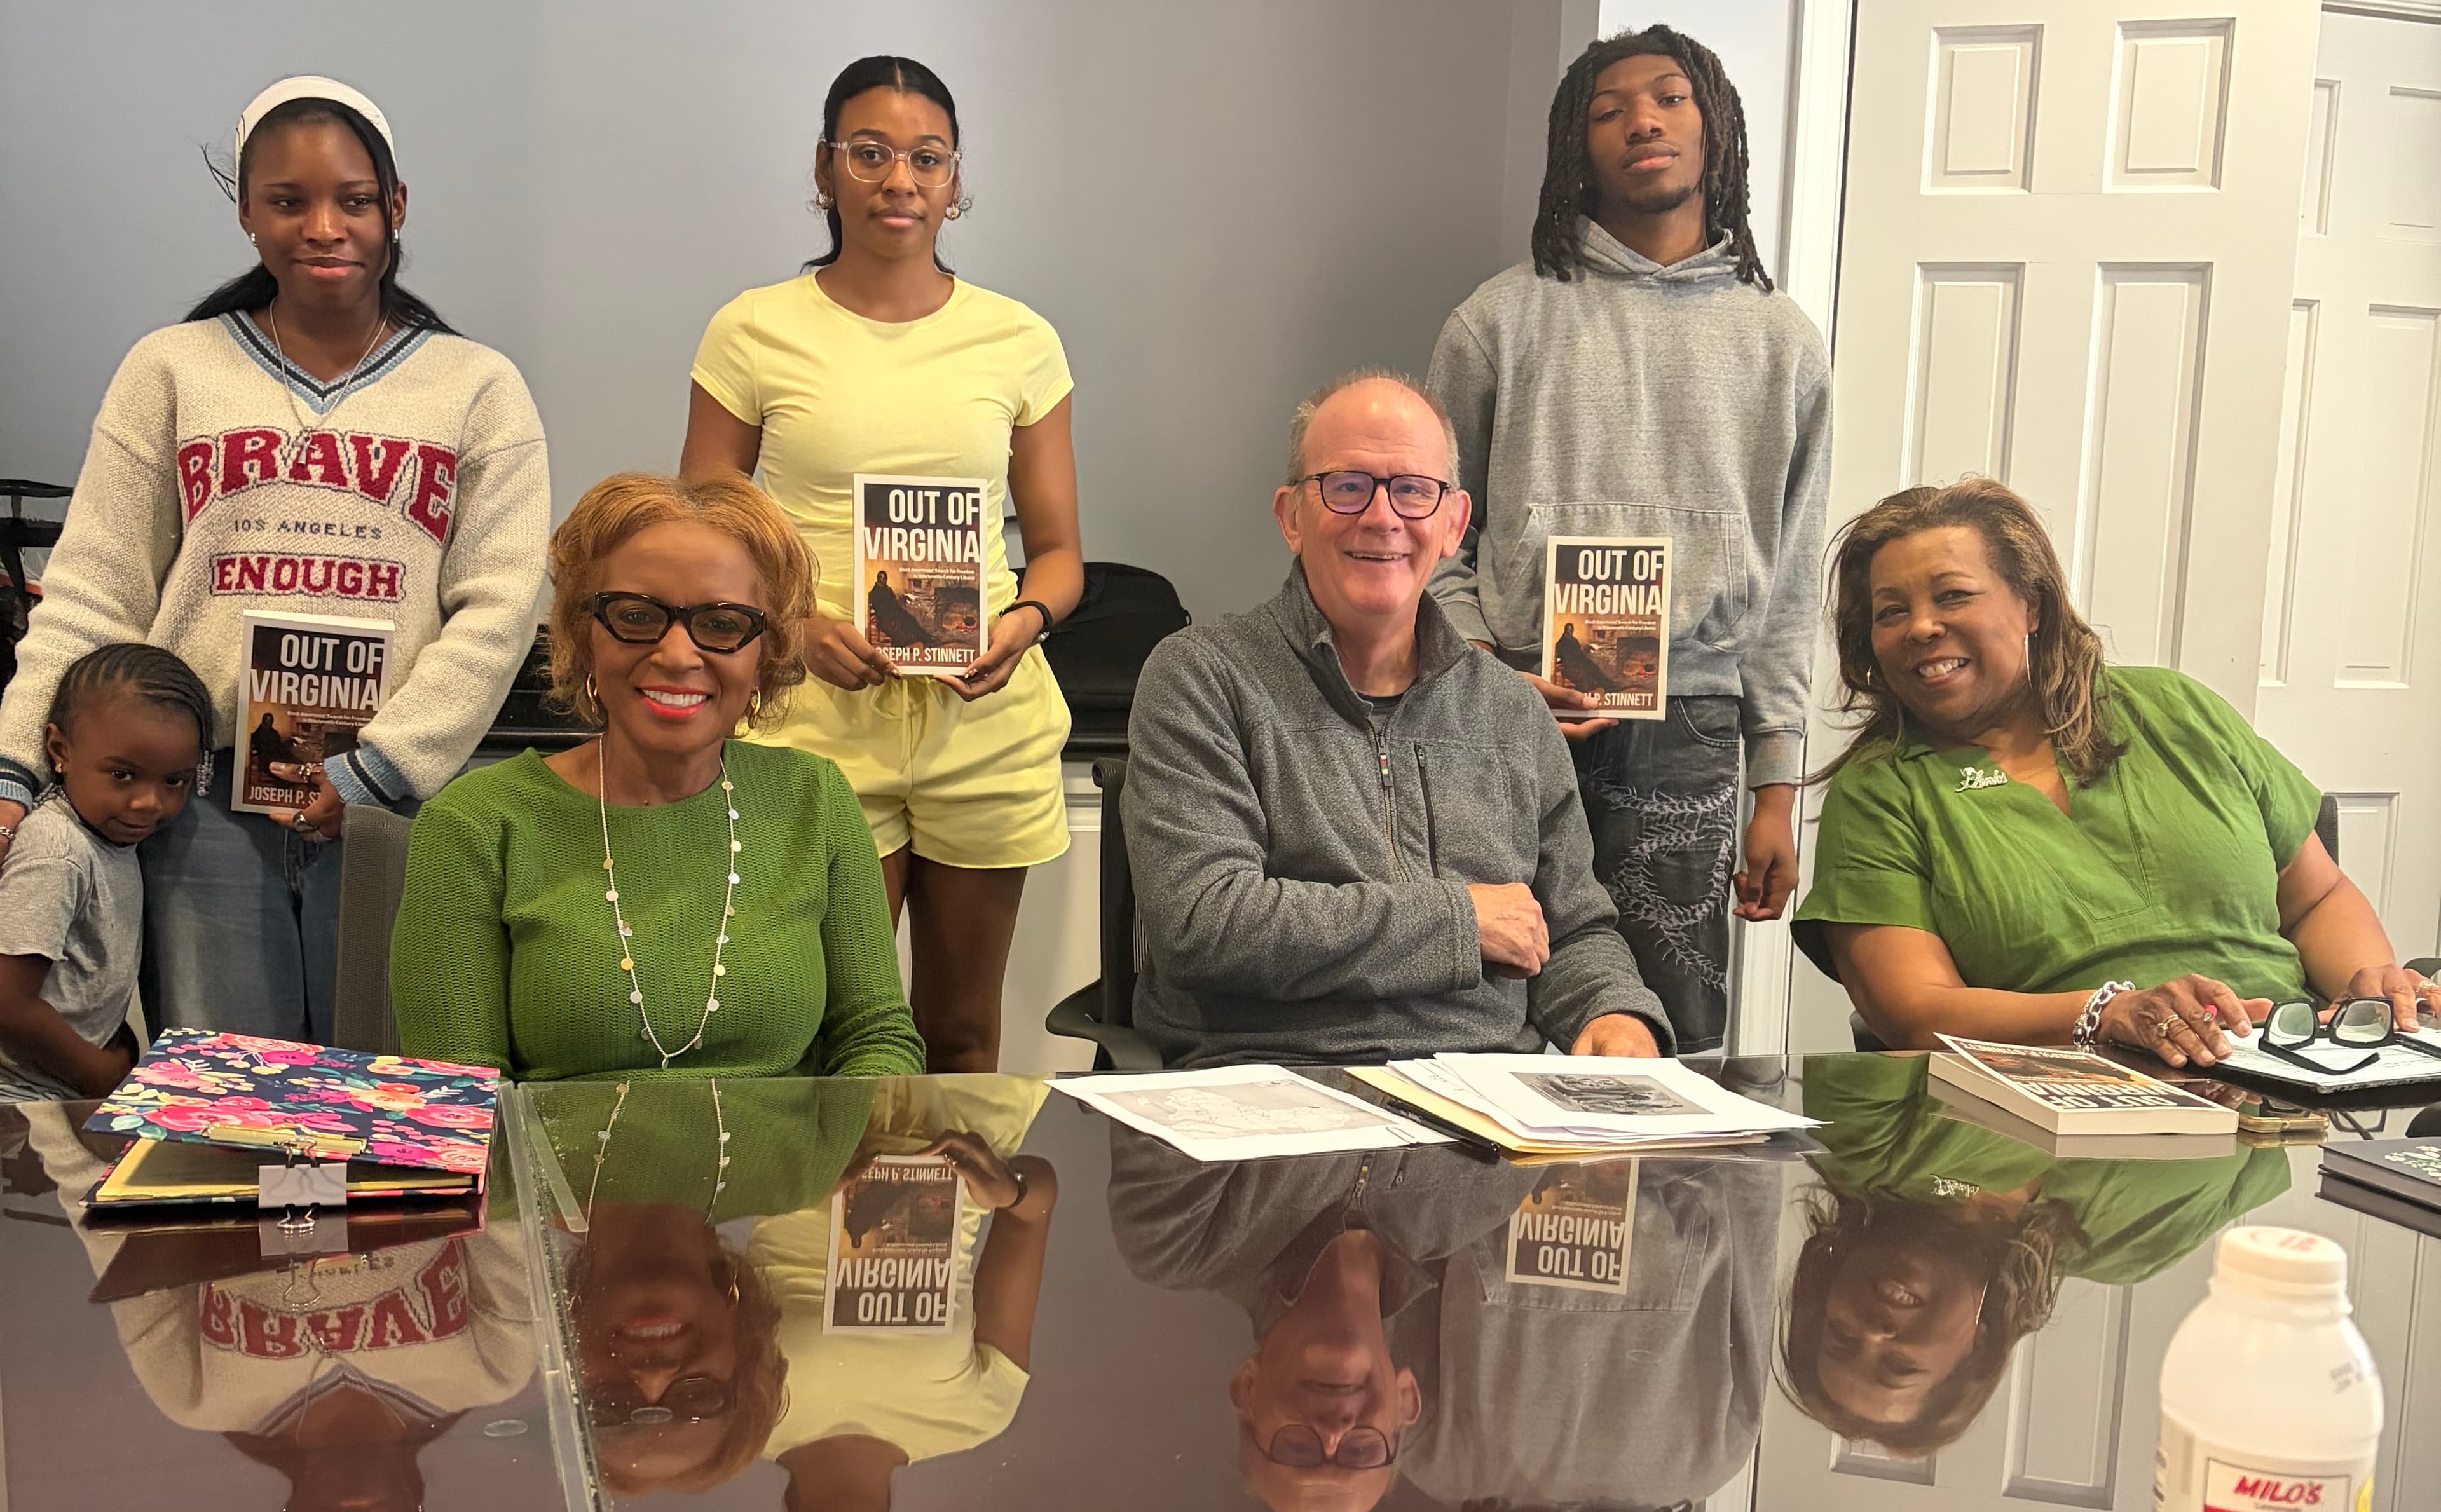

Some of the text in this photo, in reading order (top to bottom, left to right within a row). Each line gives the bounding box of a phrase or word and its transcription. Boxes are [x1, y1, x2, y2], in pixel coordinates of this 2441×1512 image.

[177, 426, 457, 545] BRAVE
[889, 489, 980, 526] OUT OF
[278, 521, 383, 540] ANGELES
[865, 526, 980, 563] VIRGINIA
[215, 556, 400, 597] ENOUGH
[1578, 549, 1664, 581] OUT OF
[1554, 583, 1662, 615] VIRGINIA
[280, 634, 385, 674] OUT OF
[876, 647, 975, 663] SEPH P. STINNETT
[250, 669, 380, 711] VIRGINIA
[1604, 693, 1653, 707] STINNETT
[249, 786, 292, 803] JOSEPH
[296, 790, 305, 805] P.
[2018, 1082, 2185, 1096] VIRGINIA
[2048, 1095, 2177, 1108] OUT OF
